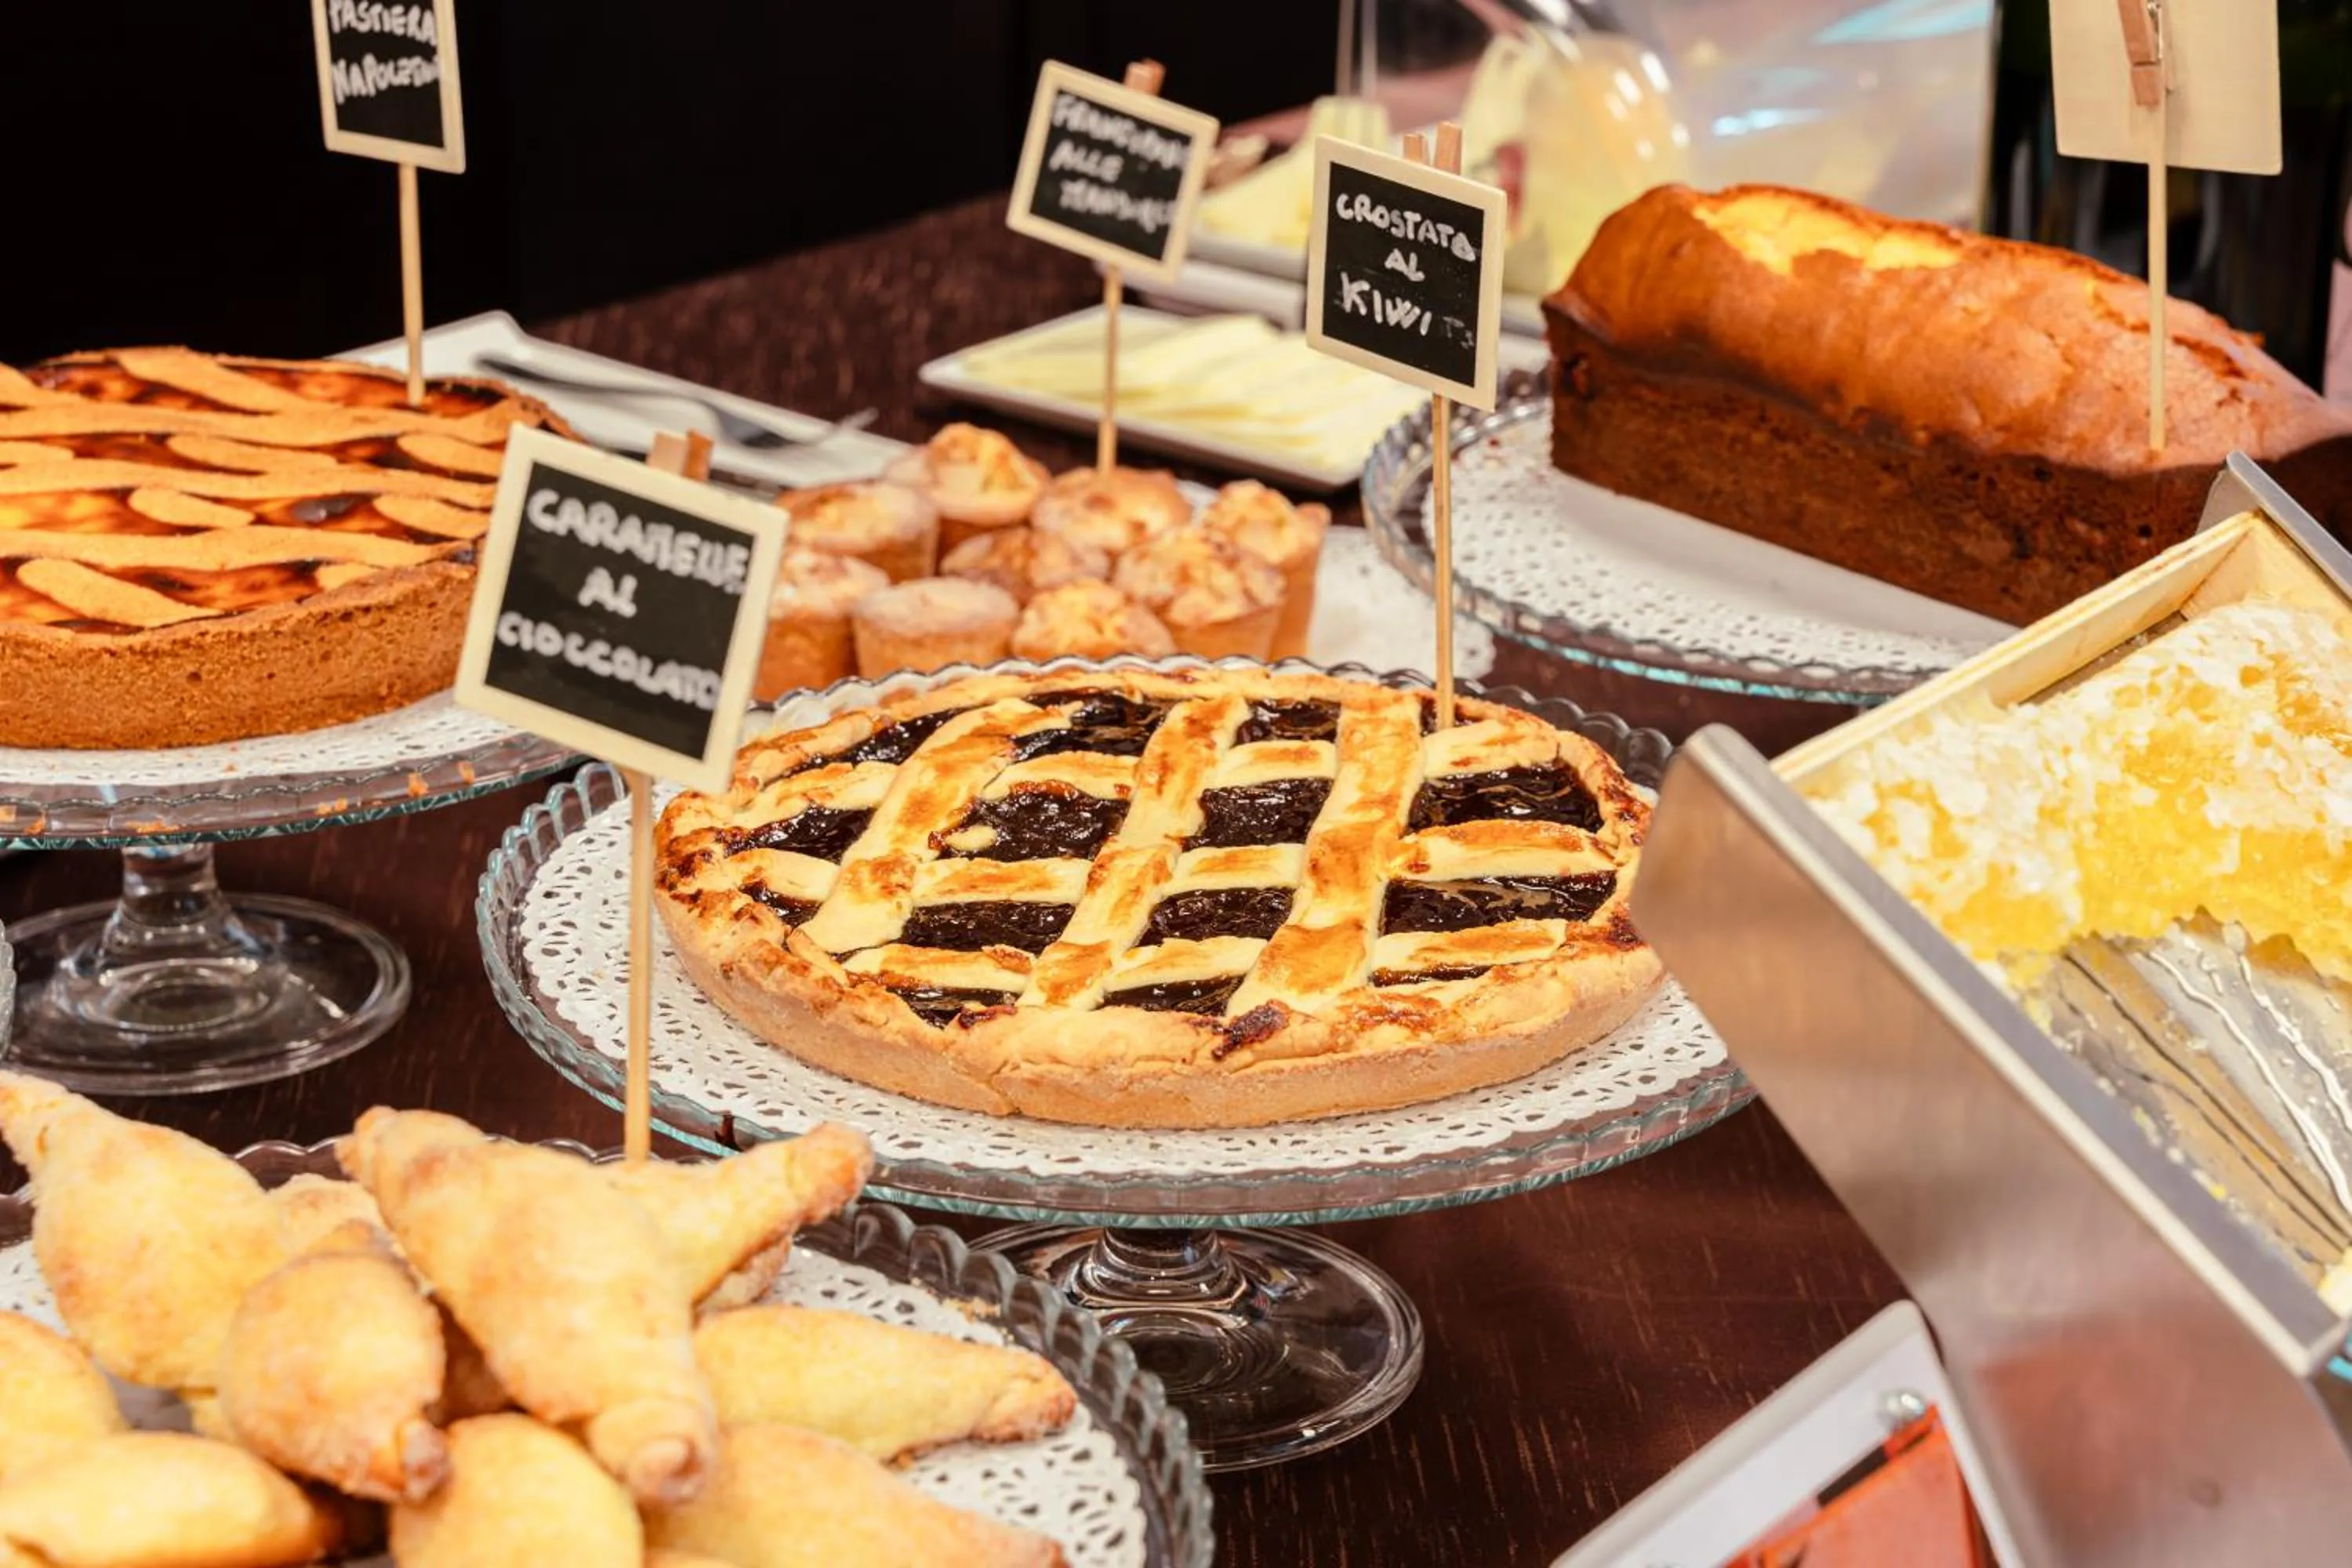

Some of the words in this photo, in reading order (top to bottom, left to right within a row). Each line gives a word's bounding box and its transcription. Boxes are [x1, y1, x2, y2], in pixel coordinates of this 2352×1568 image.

[329, 0, 437, 46] PASTIERA
[1336, 193, 1476, 262] CROSTATA
[1385, 248, 1425, 282] AL
[1339, 271, 1432, 336] KIWI
[578, 566, 638, 619] AL
[496, 611, 722, 711] CIOCCOLATO
